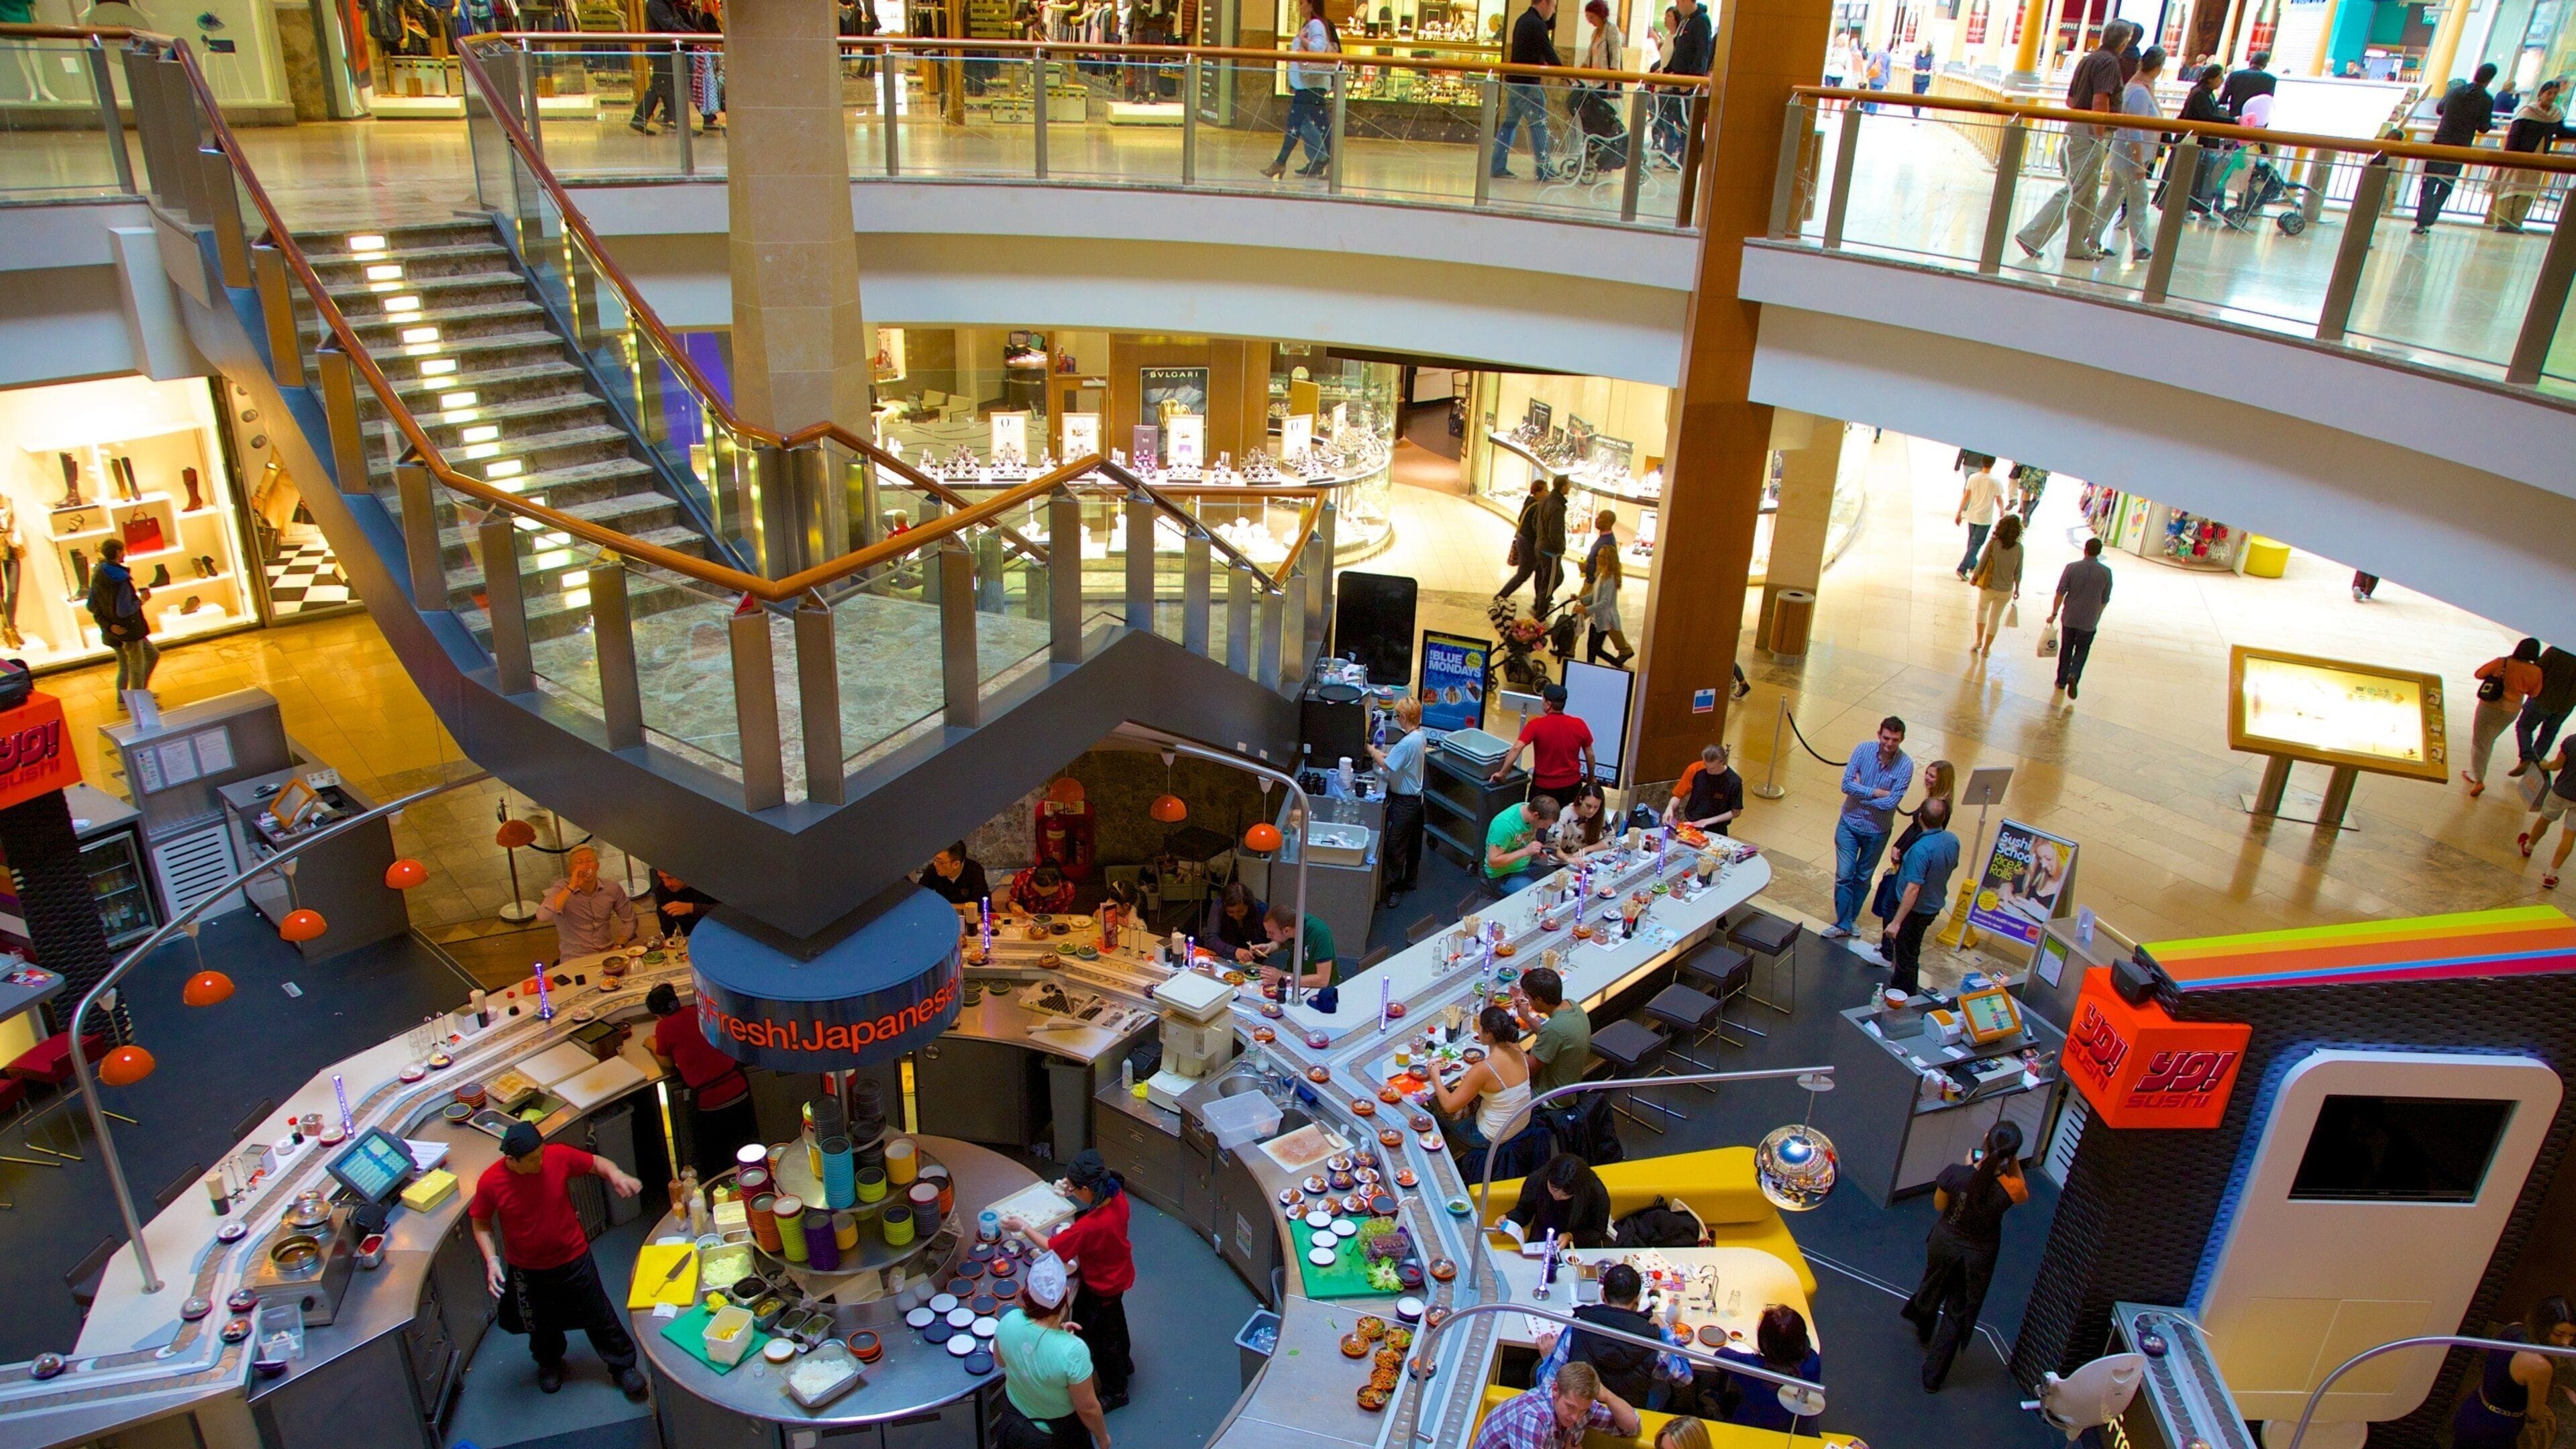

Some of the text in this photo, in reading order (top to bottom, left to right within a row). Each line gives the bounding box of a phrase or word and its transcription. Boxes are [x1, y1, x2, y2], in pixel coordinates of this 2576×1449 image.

[2059, 21, 2078, 30] OFFEE
[1428, 659, 1481, 678] MONDAYS
[2000, 832, 2032, 851] Sushi
[1993, 853, 2023, 872] Rice &
[1996, 843, 2035, 864] School
[1989, 864, 2012, 881] Rolls
